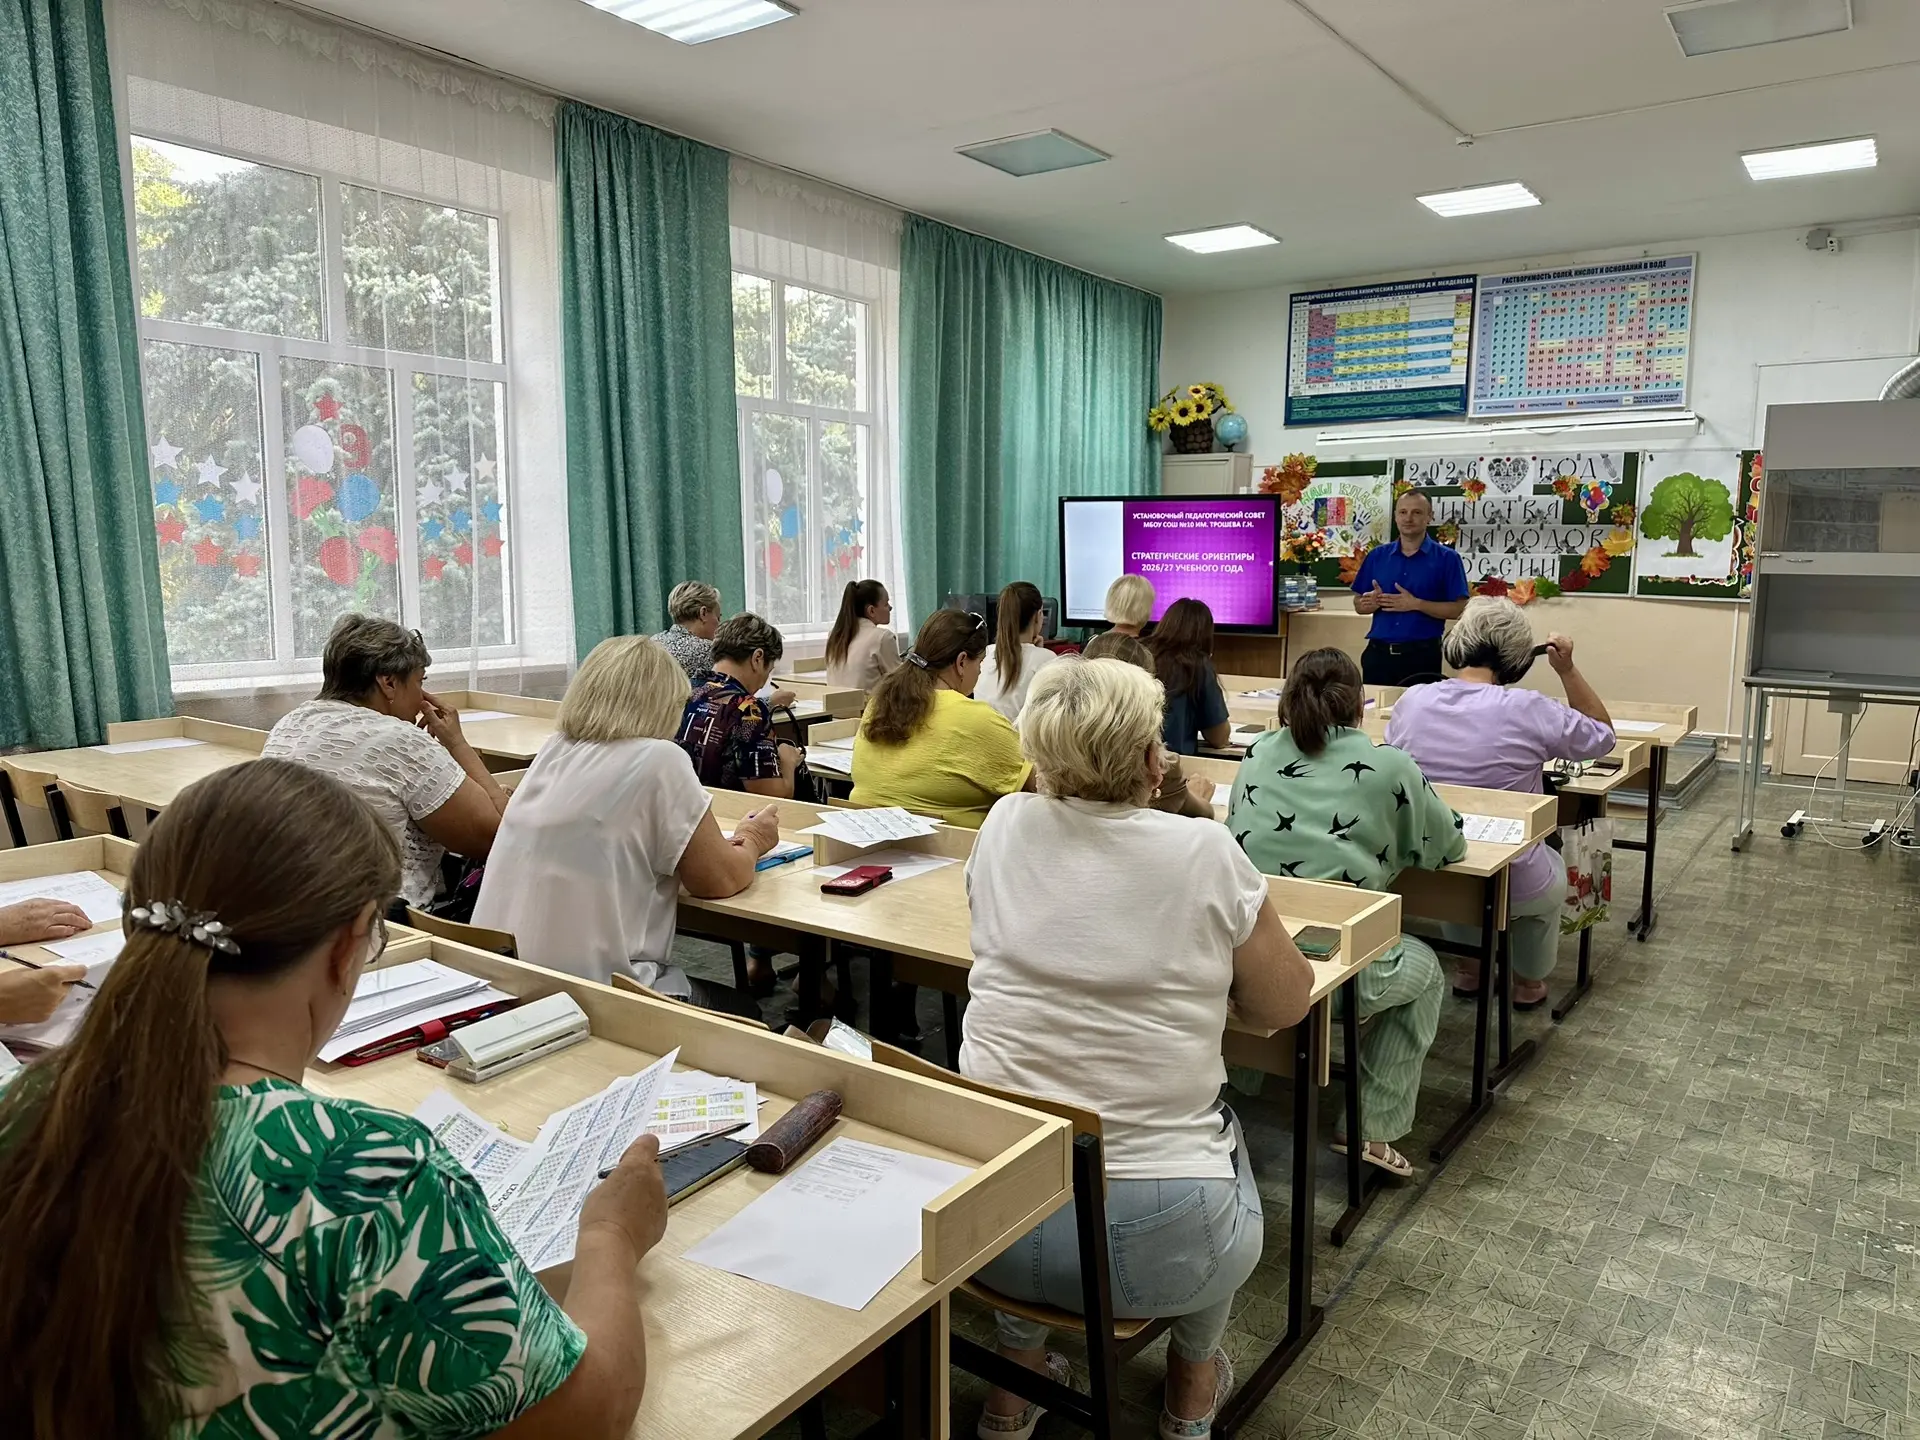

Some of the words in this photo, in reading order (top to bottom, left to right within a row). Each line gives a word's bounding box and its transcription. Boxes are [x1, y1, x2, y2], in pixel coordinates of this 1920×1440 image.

[1502, 272, 1552, 284] РАСТВОРИМОСТЬ
[1573, 267, 1599, 277] КИСЛОТ
[1599, 266, 1605, 274] И
[1605, 262, 1642, 273] ОСНОВАНИЙ
[1649, 260, 1667, 269] ВОДЕ
[1334, 289, 1358, 297] СИСТЕМА
[1394, 282, 1426, 291] ЭЛЕМЕНТОВ
[1437, 278, 1474, 287] МЕНДЕЛЕЕВА
[1409, 461, 1477, 481] 2026
[1539, 457, 1596, 479] ГОД
[1133, 511, 1184, 519] УСТАНОВОЧНЫЙ
[1185, 511, 1243, 519] ПЕДАГОГИЧЕСКИЙ
[1244, 511, 1265, 519] СОВЕТ
[1460, 528, 1604, 551] НАРОДОВ
[1131, 552, 1199, 560] СТРАТЕГИЧЕСКИЕ
[1201, 552, 1255, 561] ОРИЕНТИРЫ
[1141, 563, 1173, 572] 2026/27
[1175, 564, 1218, 572] УЧЕБНОГО
[1220, 564, 1244, 574] ГОДА
